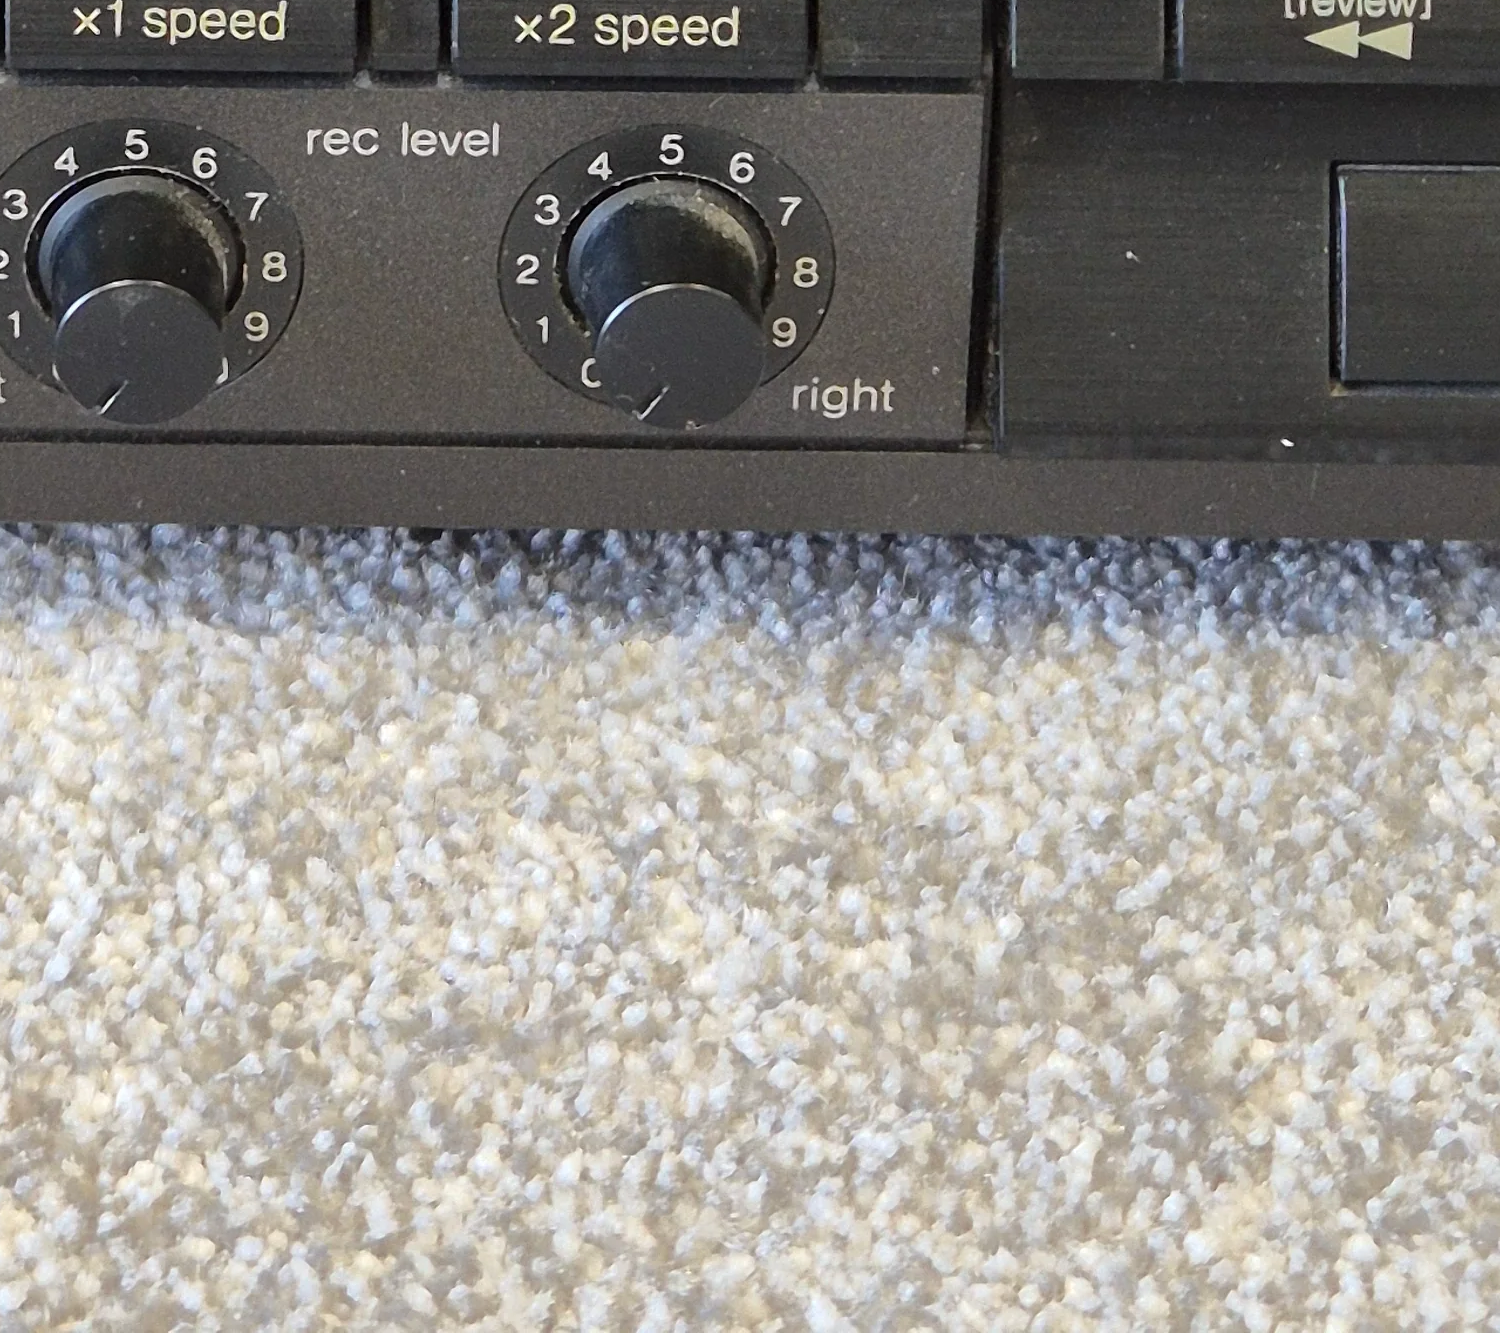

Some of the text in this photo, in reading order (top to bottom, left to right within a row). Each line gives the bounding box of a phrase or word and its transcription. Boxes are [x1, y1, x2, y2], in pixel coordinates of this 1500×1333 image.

[142, 0, 288, 45] speed
[593, 5, 741, 54] speed
[124, 129, 148, 160] 5
[306, 122, 500, 158] rec level
[659, 134, 684, 165] 5
[54, 147, 79, 176] 4
[192, 147, 217, 179] 6
[588, 151, 612, 180] 4
[729, 151, 755, 183] 6
[3, 189, 28, 220] 3
[245, 192, 268, 221] 7
[534, 194, 560, 226] 3
[779, 197, 802, 226] 7
[261, 250, 287, 282] 8
[516, 254, 539, 285] 2
[793, 257, 819, 288] 8
[8, 310, 20, 338] 1
[244, 312, 269, 341] 9
[536, 316, 549, 344] 1
[772, 317, 797, 348] 9
[792, 377, 895, 418] right
